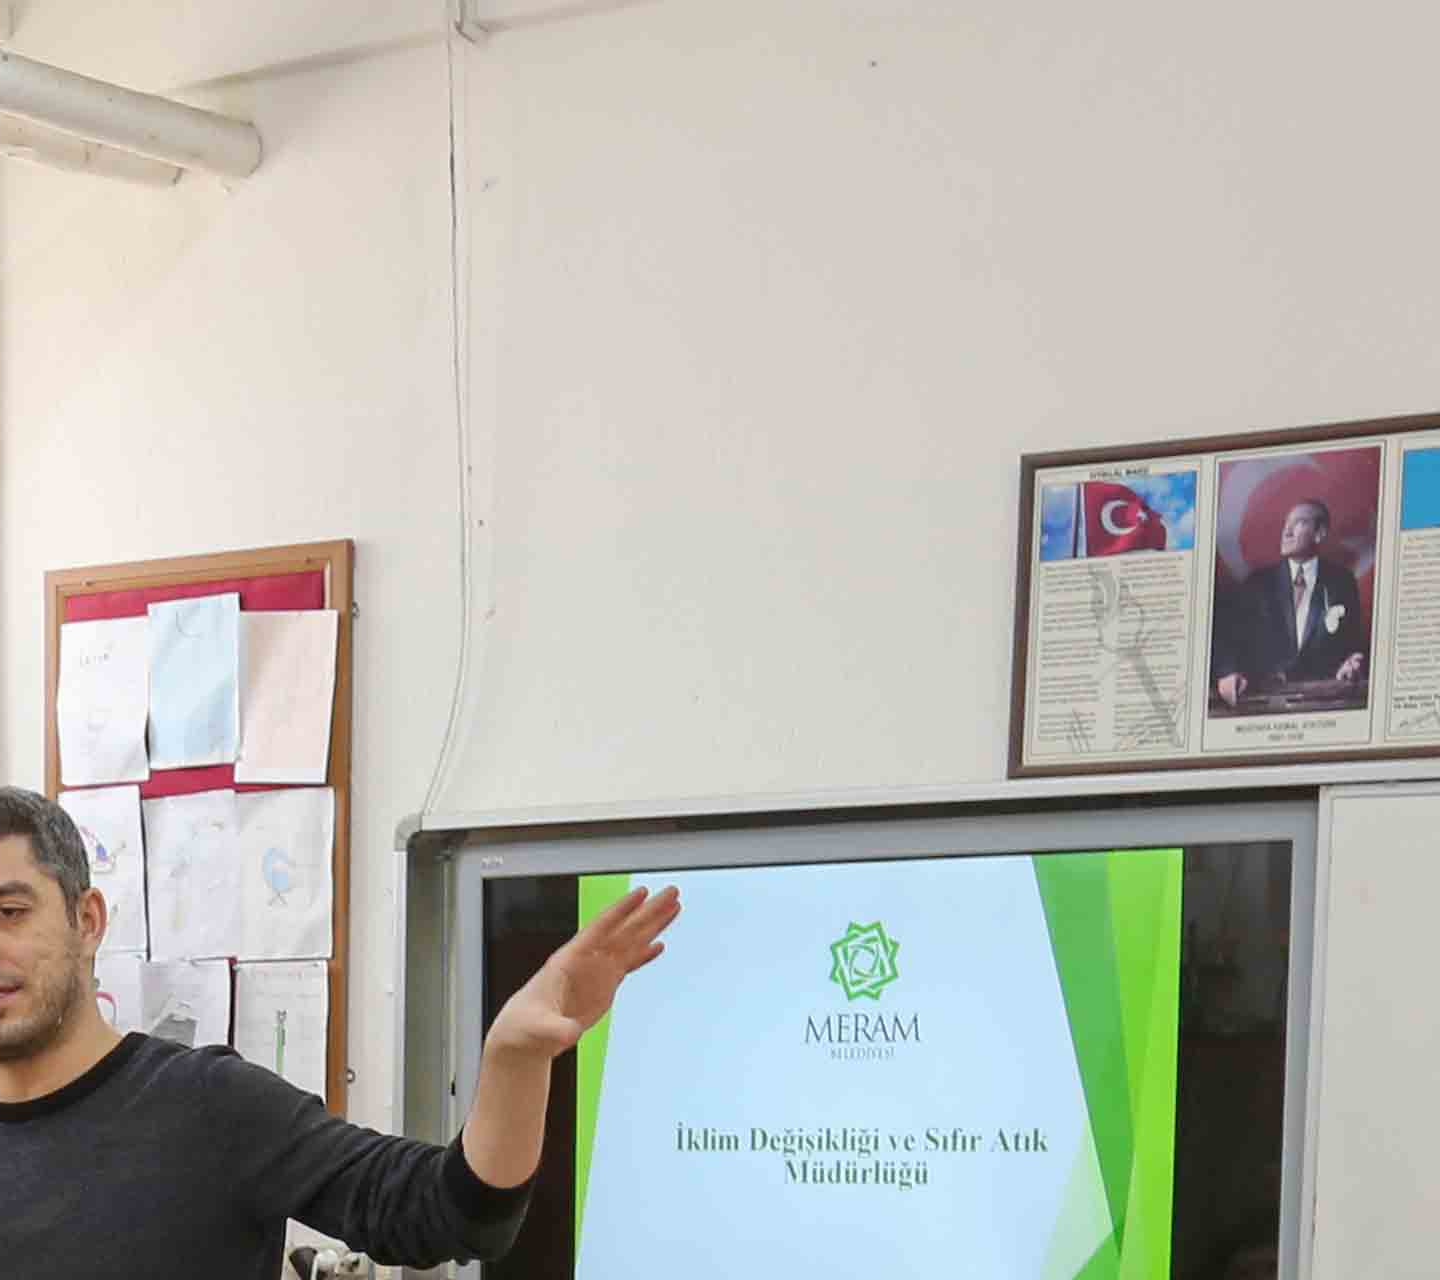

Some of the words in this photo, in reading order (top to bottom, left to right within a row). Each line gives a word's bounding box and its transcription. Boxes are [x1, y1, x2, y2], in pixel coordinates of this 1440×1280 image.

[804, 1012, 920, 1043] MERAM
[675, 1121, 740, 1153] İklim
[749, 1126, 881, 1158] Değişikliği
[888, 1132, 917, 1153] ve
[990, 1126, 1050, 1153] Atık
[783, 1158, 929, 1191] Müdürlüğü
